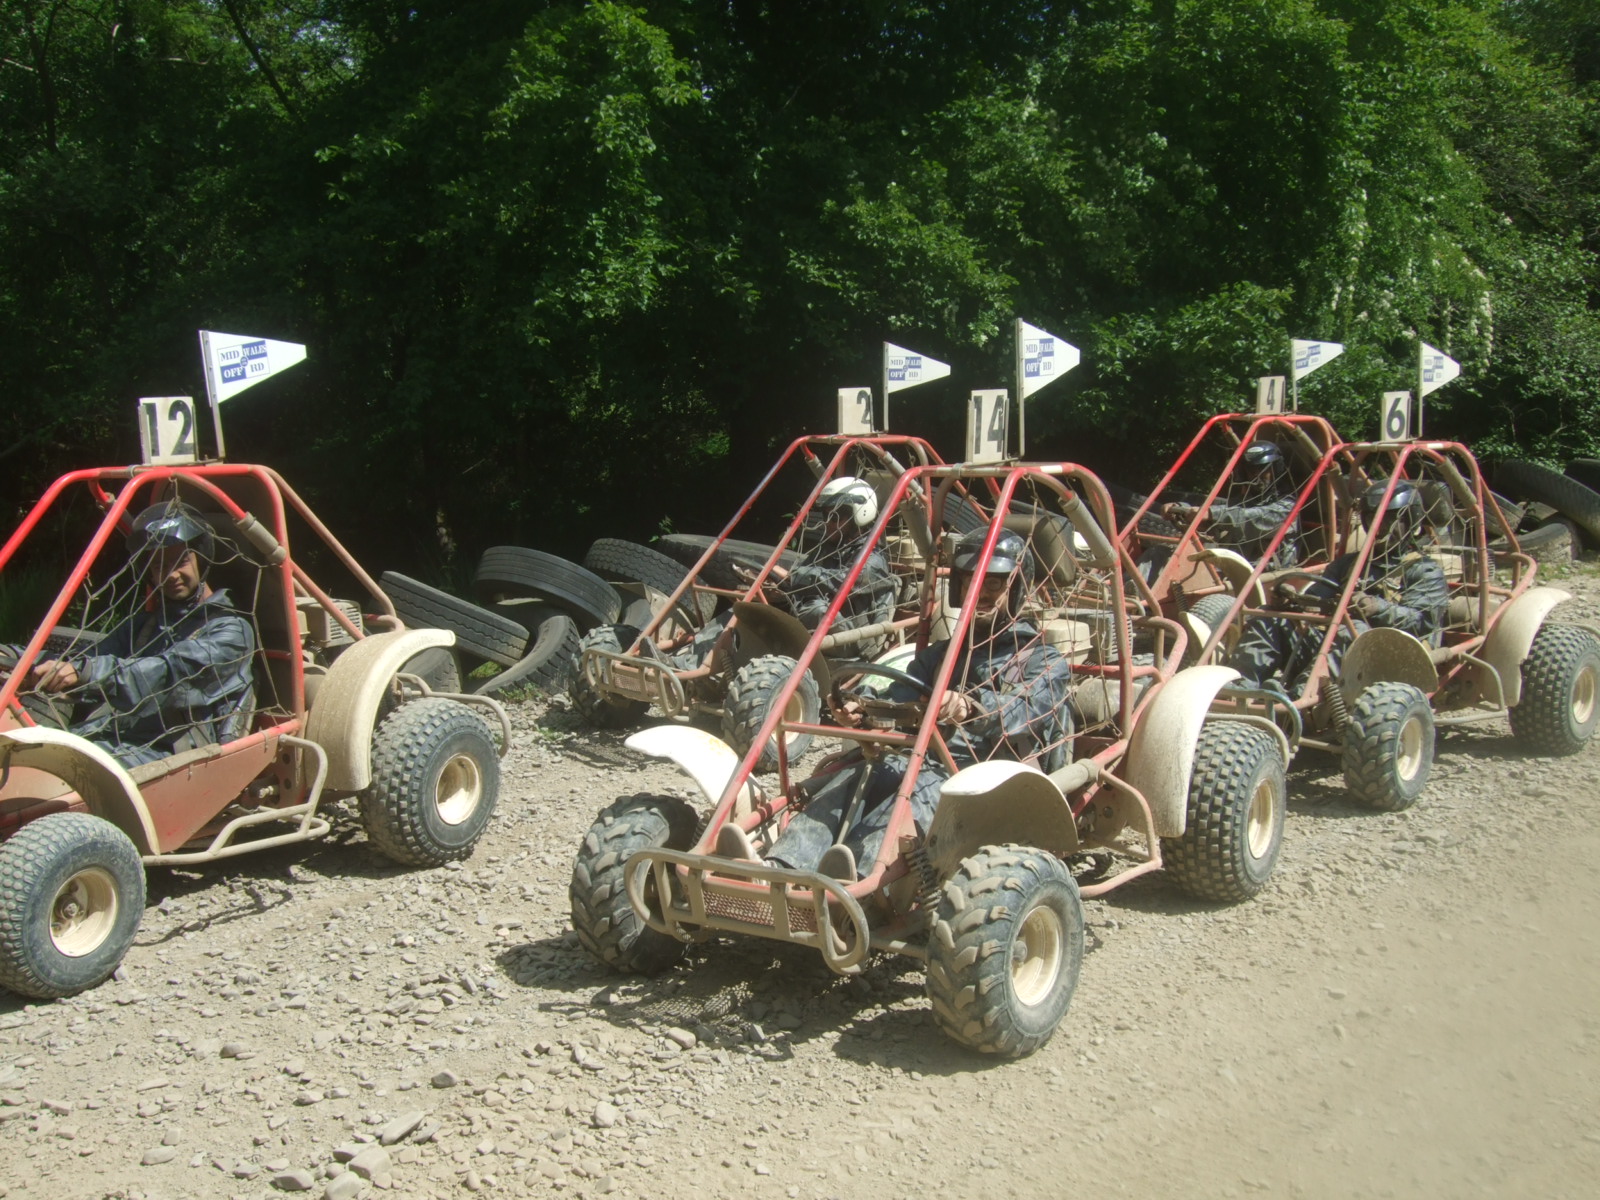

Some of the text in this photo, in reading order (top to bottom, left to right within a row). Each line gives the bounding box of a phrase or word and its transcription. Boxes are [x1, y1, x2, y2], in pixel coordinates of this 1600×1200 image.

[220, 345, 267, 361] MID WALES
[1026, 344, 1038, 353] MID
[223, 362, 265, 379] OFF RD
[1026, 362, 1039, 372] OFF
[856, 389, 871, 425] 2
[1266, 379, 1276, 411] 4
[142, 399, 195, 457] 12
[973, 394, 1005, 455] 14
[1386, 397, 1406, 440] 6
